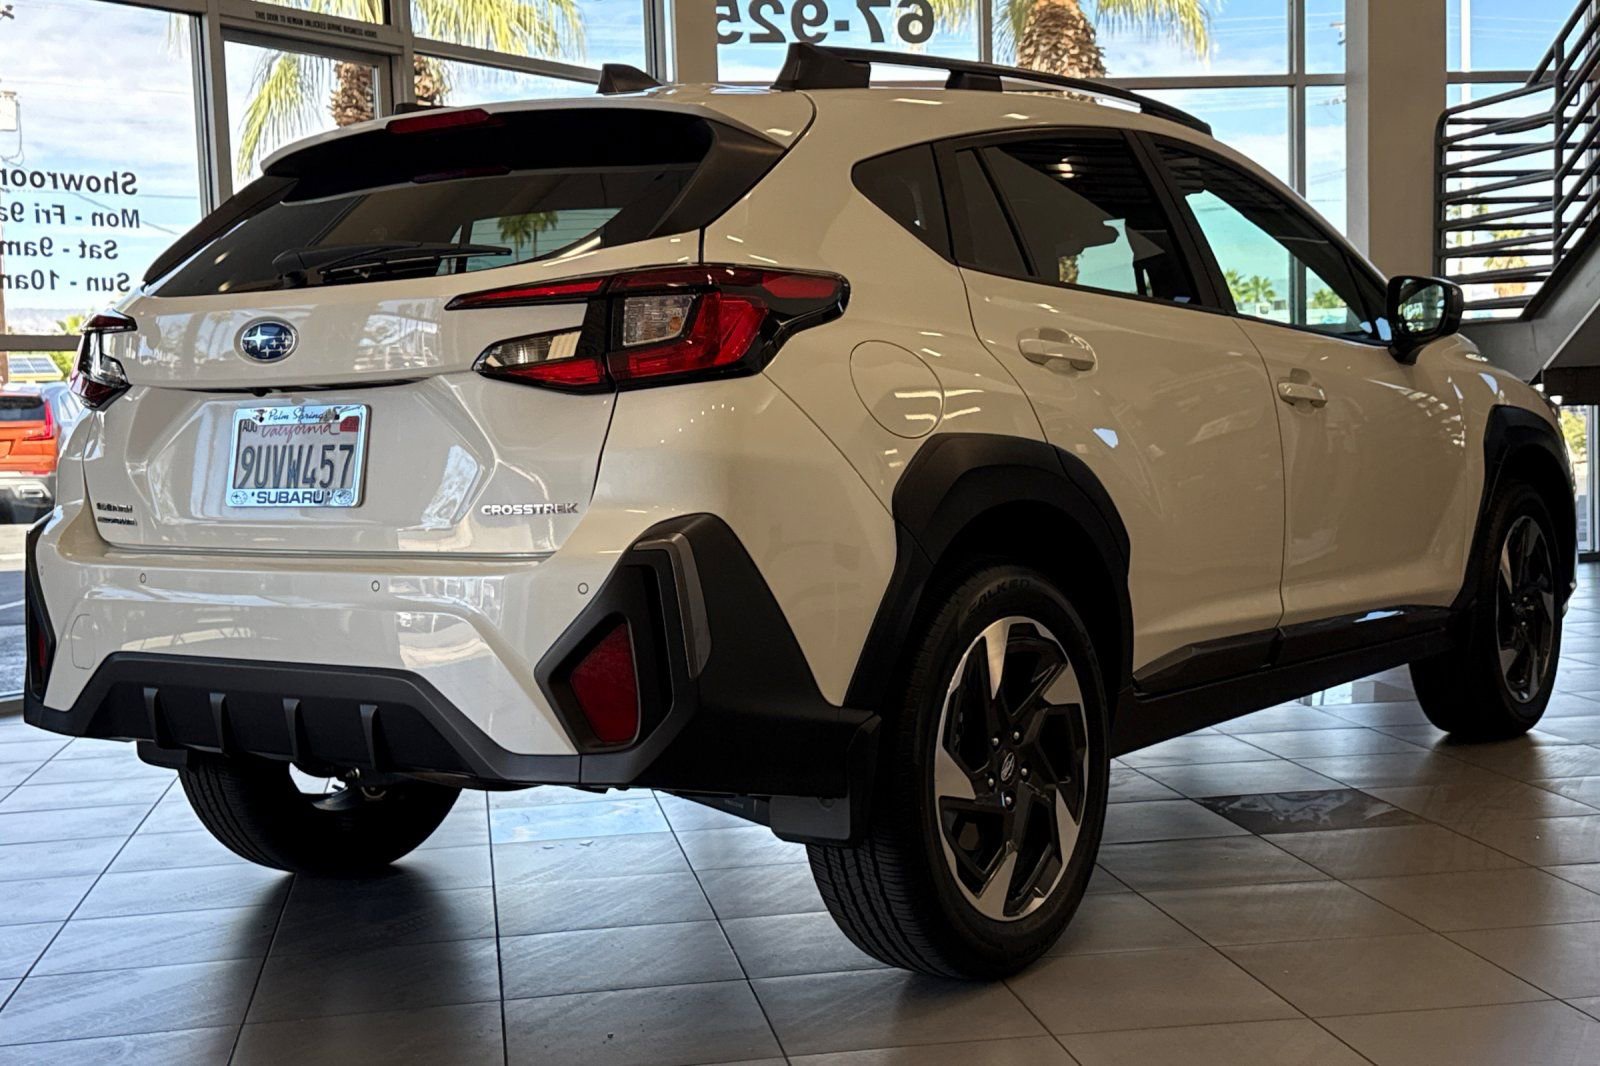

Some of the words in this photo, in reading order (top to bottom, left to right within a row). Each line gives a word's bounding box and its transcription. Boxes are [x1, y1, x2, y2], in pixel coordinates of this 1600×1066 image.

[268, 408, 290, 421] Palm
[237, 443, 355, 489] 9UVW457
[256, 490, 325, 504] SUBARU
[480, 503, 579, 516] CROSSTREK
